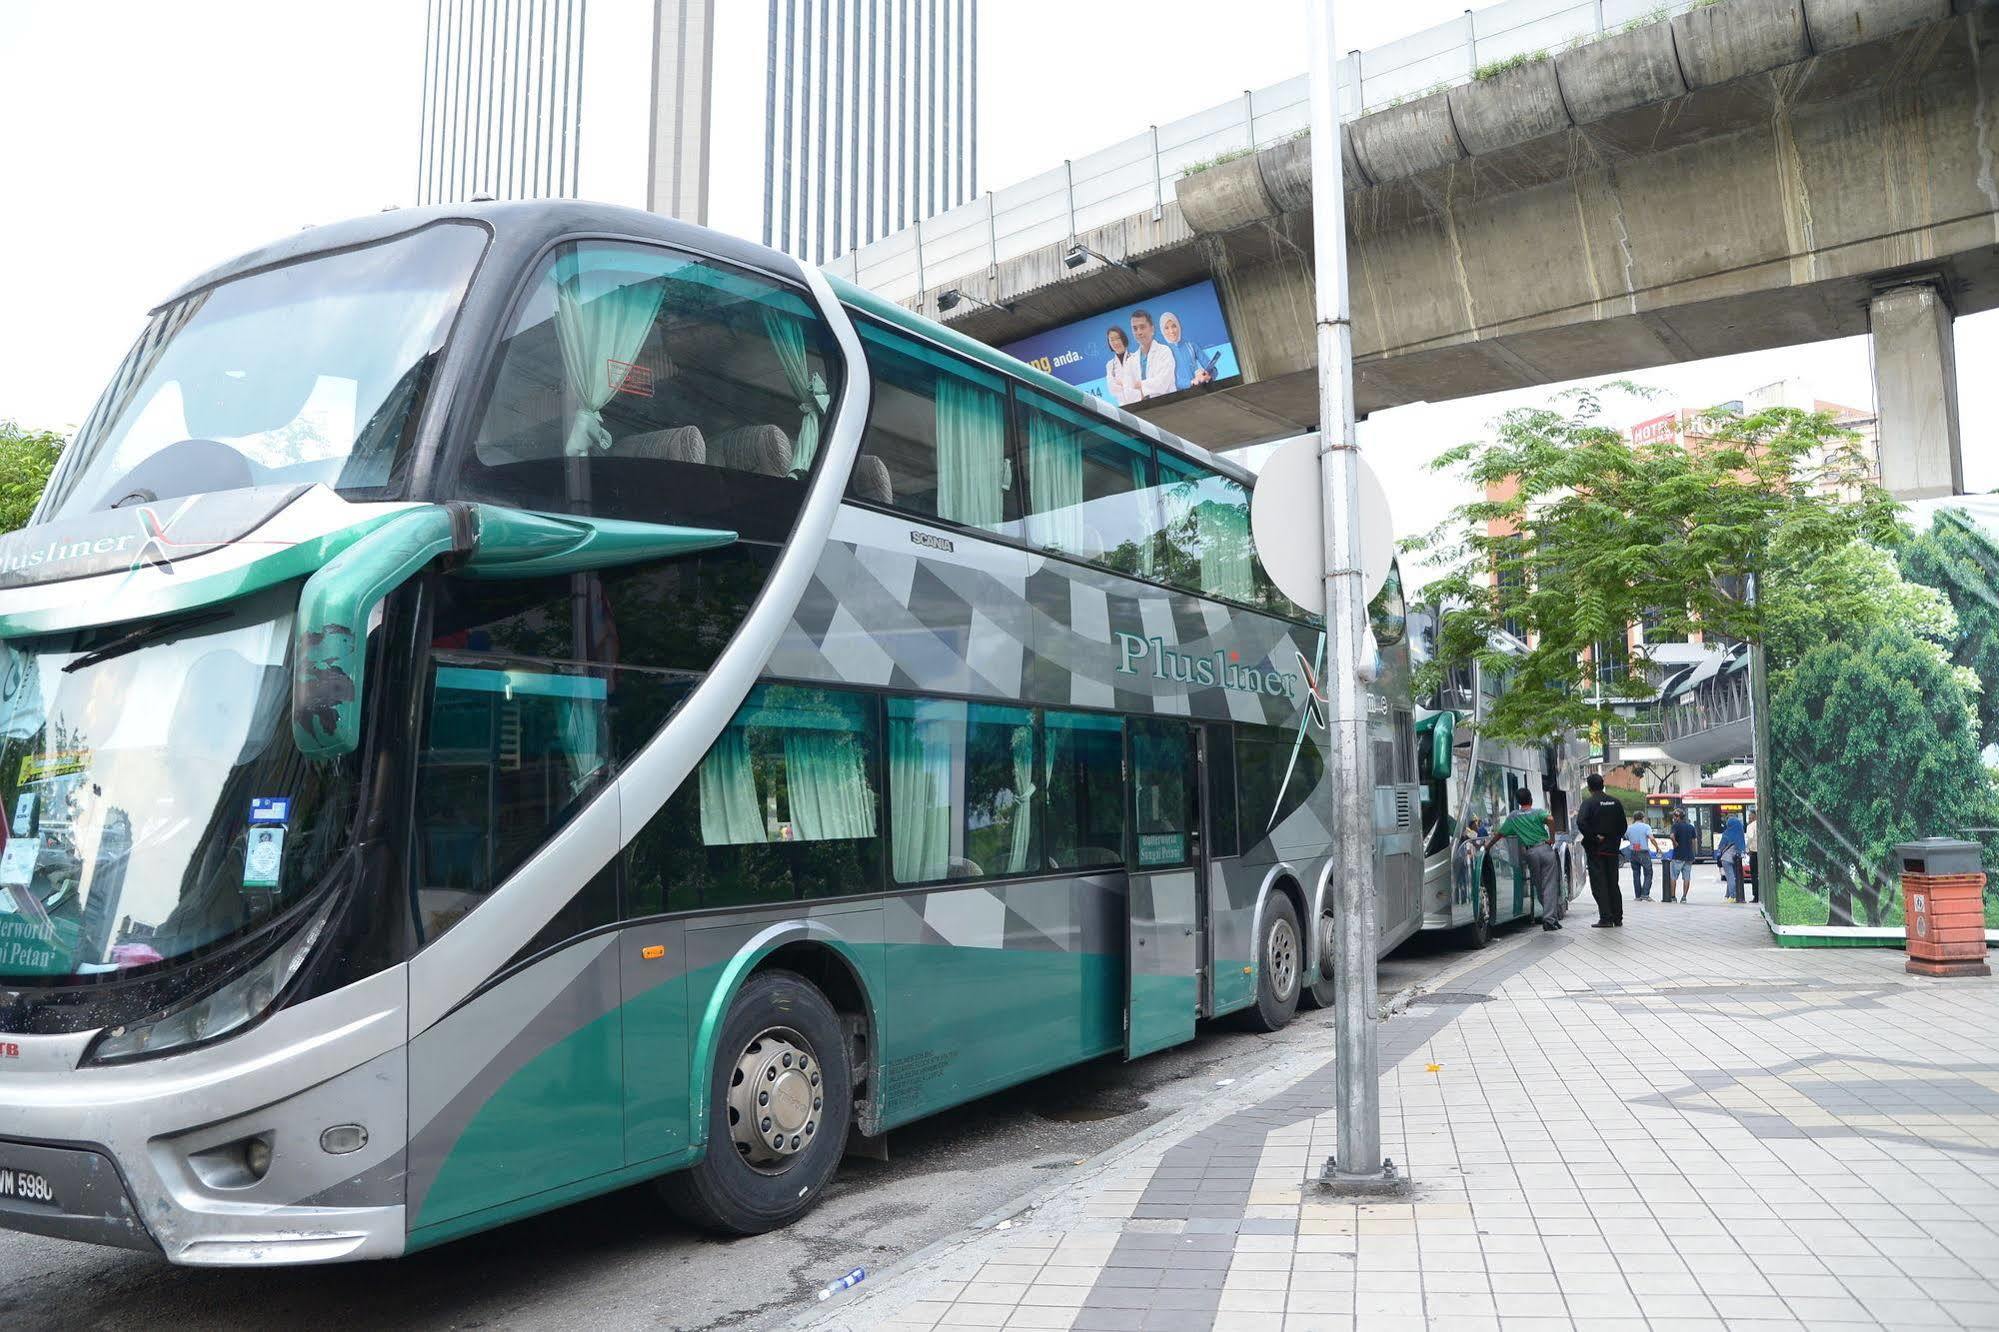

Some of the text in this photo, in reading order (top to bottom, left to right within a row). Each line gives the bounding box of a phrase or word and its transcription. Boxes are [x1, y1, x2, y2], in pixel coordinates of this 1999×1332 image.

[1053, 350, 1083, 368] anda.
[912, 531, 953, 552] SCANIA
[0, 535, 135, 574] lusliner
[1115, 631, 1297, 698] Plusliner
[0, 920, 53, 941] erworth
